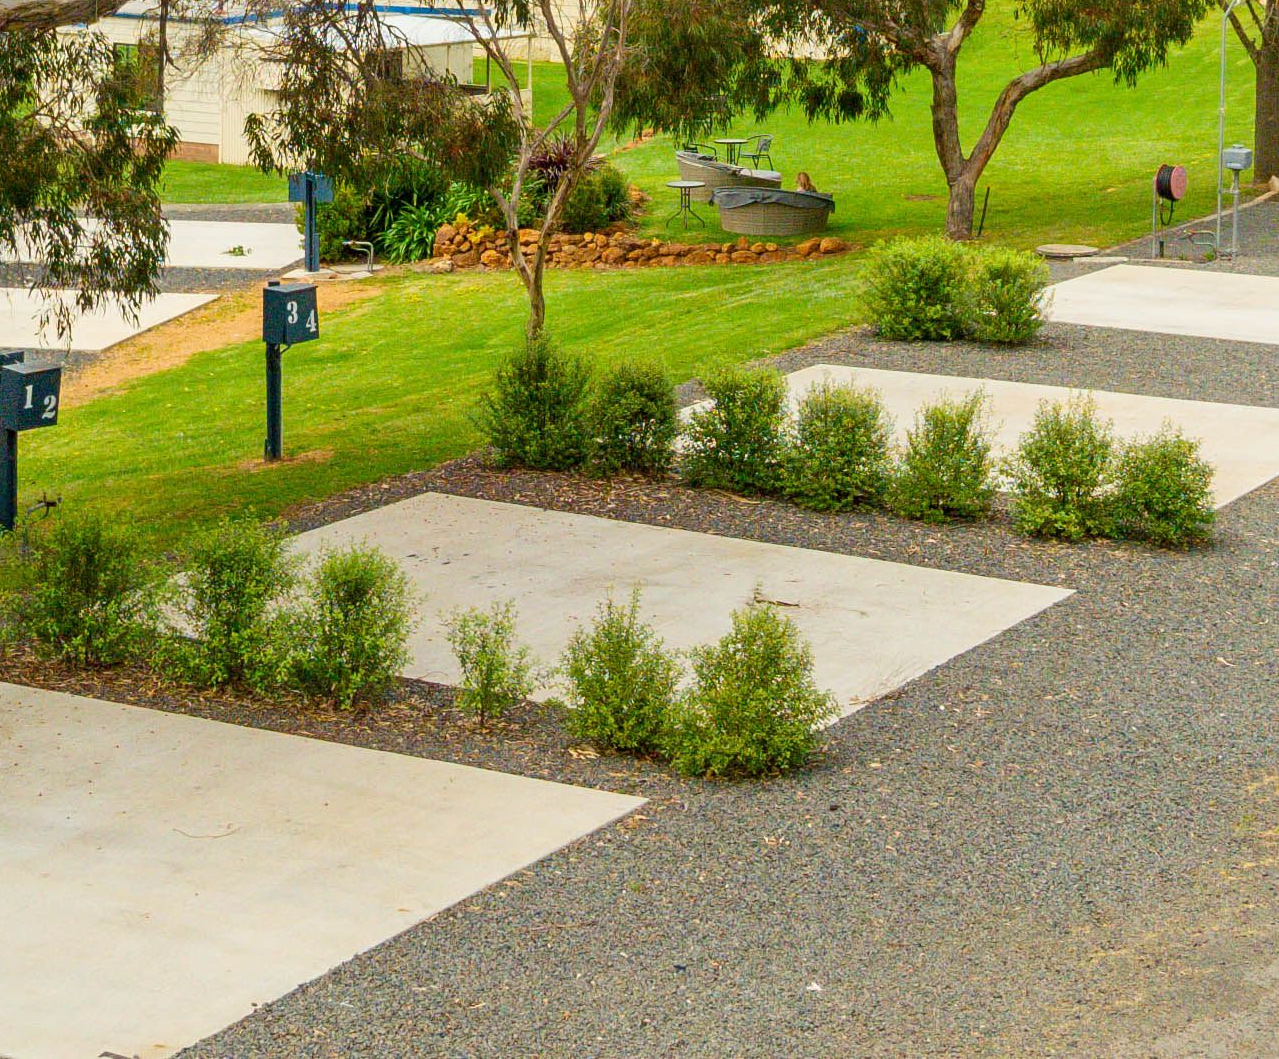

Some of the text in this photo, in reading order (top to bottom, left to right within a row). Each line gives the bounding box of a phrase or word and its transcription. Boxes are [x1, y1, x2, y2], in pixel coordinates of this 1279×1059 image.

[287, 301, 317, 332] 3 4
[24, 385, 56, 419] 1 2
